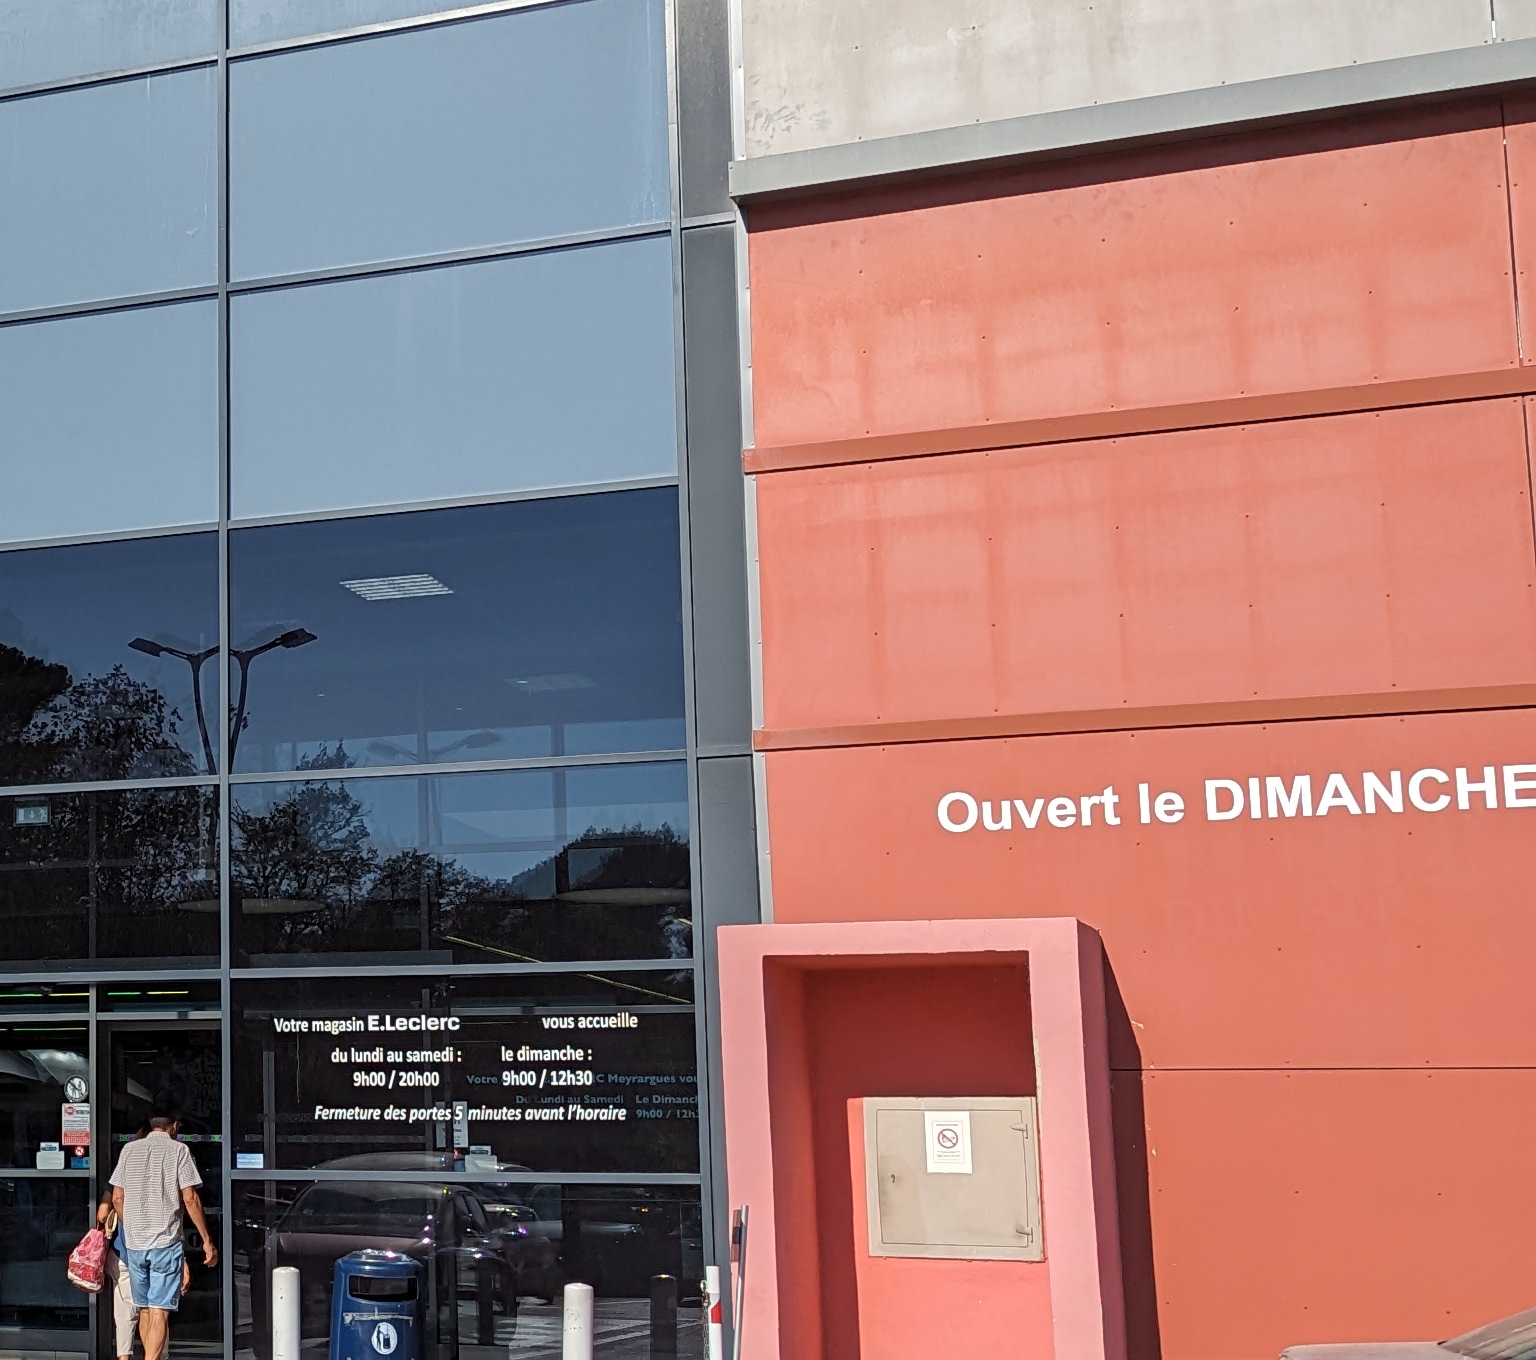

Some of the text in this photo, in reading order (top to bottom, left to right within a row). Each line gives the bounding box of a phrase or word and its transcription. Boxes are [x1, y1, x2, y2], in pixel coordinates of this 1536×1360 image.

[938, 763, 1536, 833] Ouvert le DIMANCHE
[274, 1012, 639, 1035] Votre magasin E.Leclerc vous accueille
[331, 1047, 348, 1063] du
[351, 1047, 384, 1063] lundi
[386, 1050, 403, 1063] au
[406, 1046, 454, 1063] samedi
[501, 1045, 514, 1062] le
[517, 1045, 584, 1061] dimanche
[353, 1069, 440, 1090] 9h00 / 20h00
[466, 1074, 498, 1084] Votre
[608, 1073, 677, 1087] Meyrargues
[502, 1070, 536, 1086] 9h00
[539, 1069, 547, 1088] /
[550, 1070, 593, 1086] 12h30
[567, 1096, 581, 1104] au
[584, 1094, 624, 1104] Samedi
[636, 1094, 650, 1104] Le
[315, 1104, 626, 1123] Fermeture des portes 5 minutes avant l'horaire
[636, 1109, 663, 1118] 9h00
